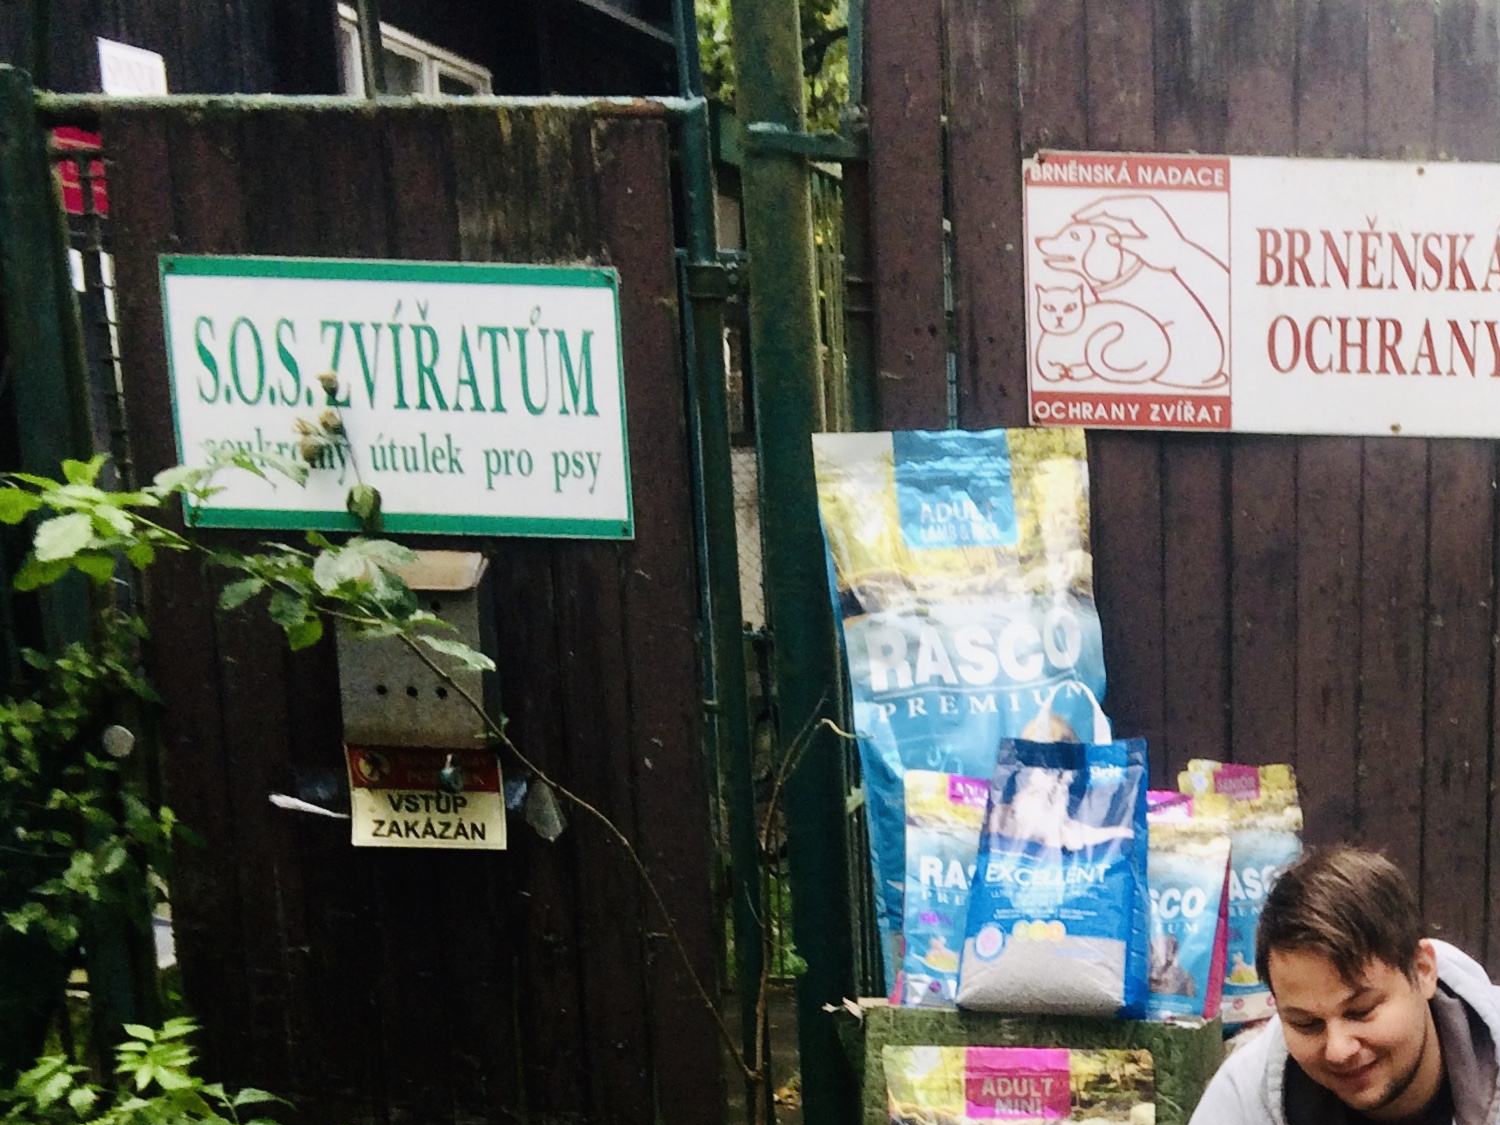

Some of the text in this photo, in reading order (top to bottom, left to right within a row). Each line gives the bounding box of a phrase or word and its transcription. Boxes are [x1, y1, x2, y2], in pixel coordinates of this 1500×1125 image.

[1030, 159, 1224, 186] BRNĚNSKÁ NADACE
[1034, 400, 1223, 423] OCHRANY ZVÍŘAT
[369, 432, 464, 474] útulek
[483, 447, 534, 491] pro
[551, 447, 602, 494] psy
[864, 607, 1082, 692] RASCO
[387, 793, 468, 815] VSTUP
[371, 818, 486, 840] ZAKÁZÁN
[985, 863, 1112, 886] EXCELLENT
[982, 1076, 1055, 1097] ADULT
[995, 1097, 1044, 1116] MINI
